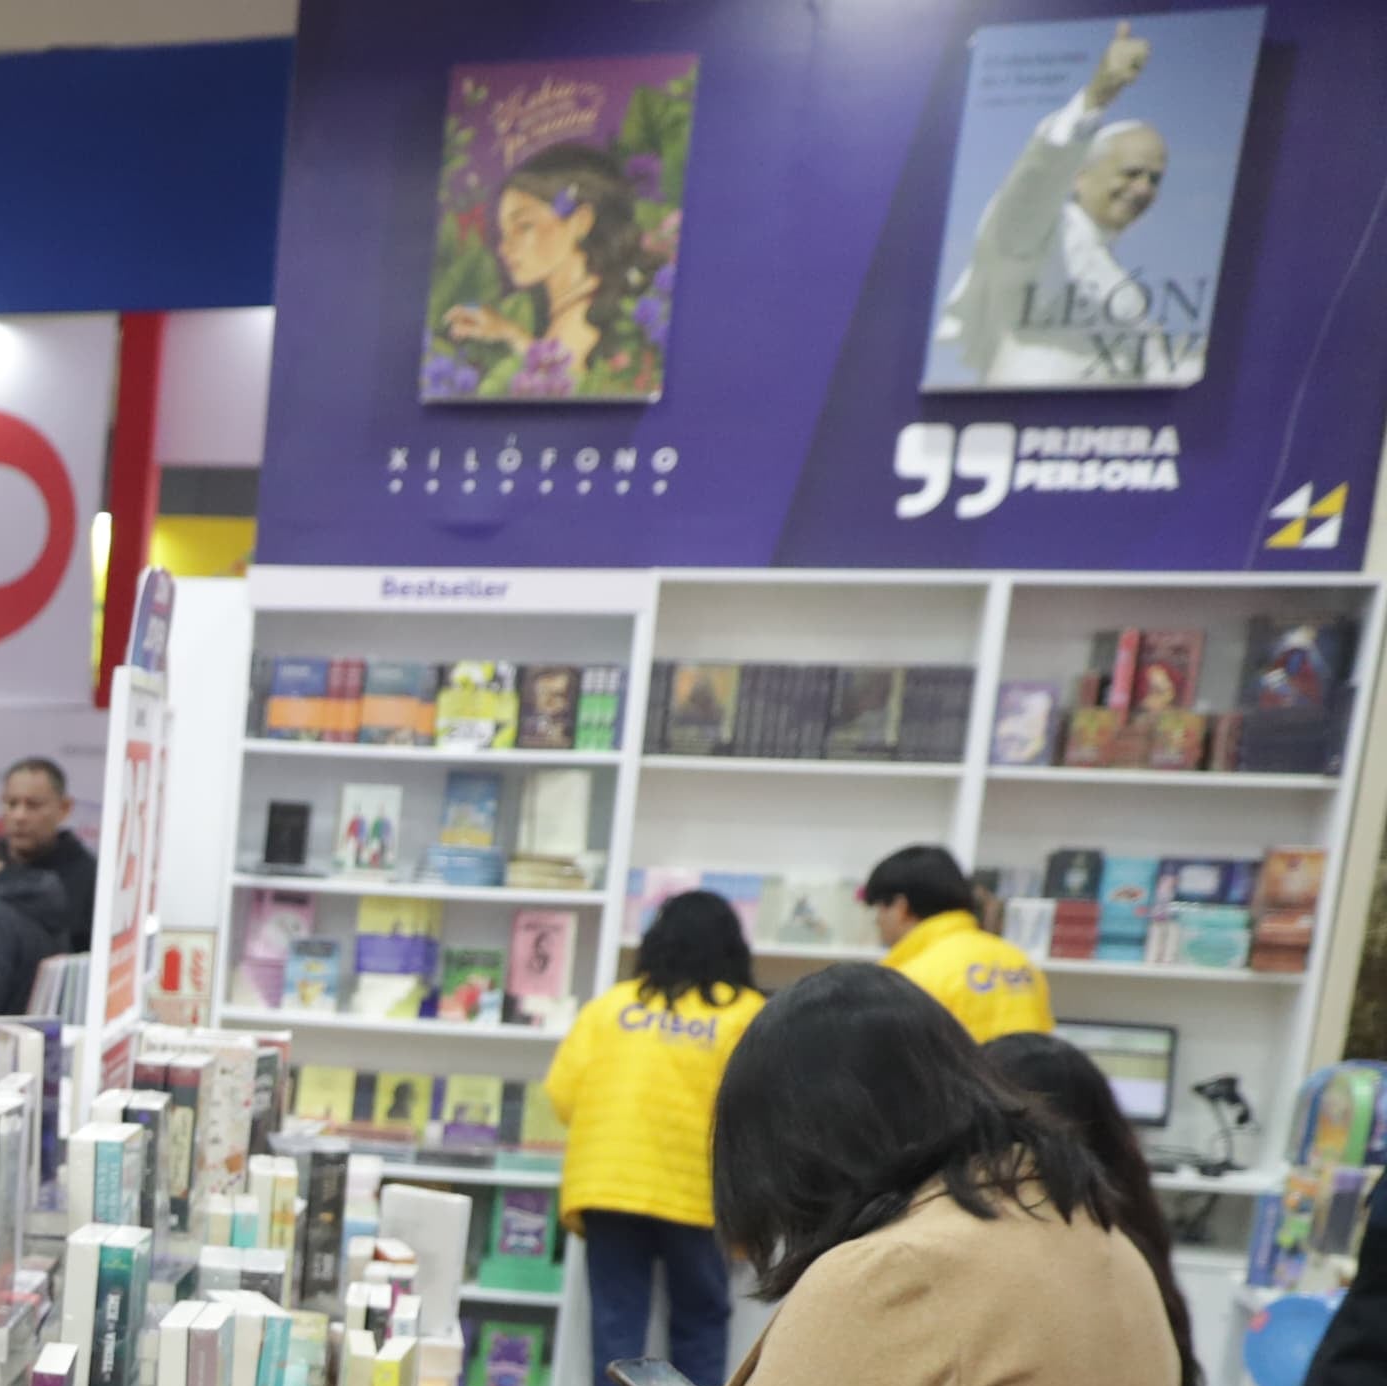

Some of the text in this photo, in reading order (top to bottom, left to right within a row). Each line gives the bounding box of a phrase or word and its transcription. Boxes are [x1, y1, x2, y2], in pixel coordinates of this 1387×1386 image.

[1018, 267, 1207, 330] LEÓN
[1083, 333, 1204, 379] XIV
[387, 432, 679, 474] XILÓFONO
[1018, 425, 1180, 457] PRIMERA
[1012, 459, 1180, 491] PERSONA
[380, 577, 510, 602] Bestseller
[618, 1003, 716, 1042] Crisol
